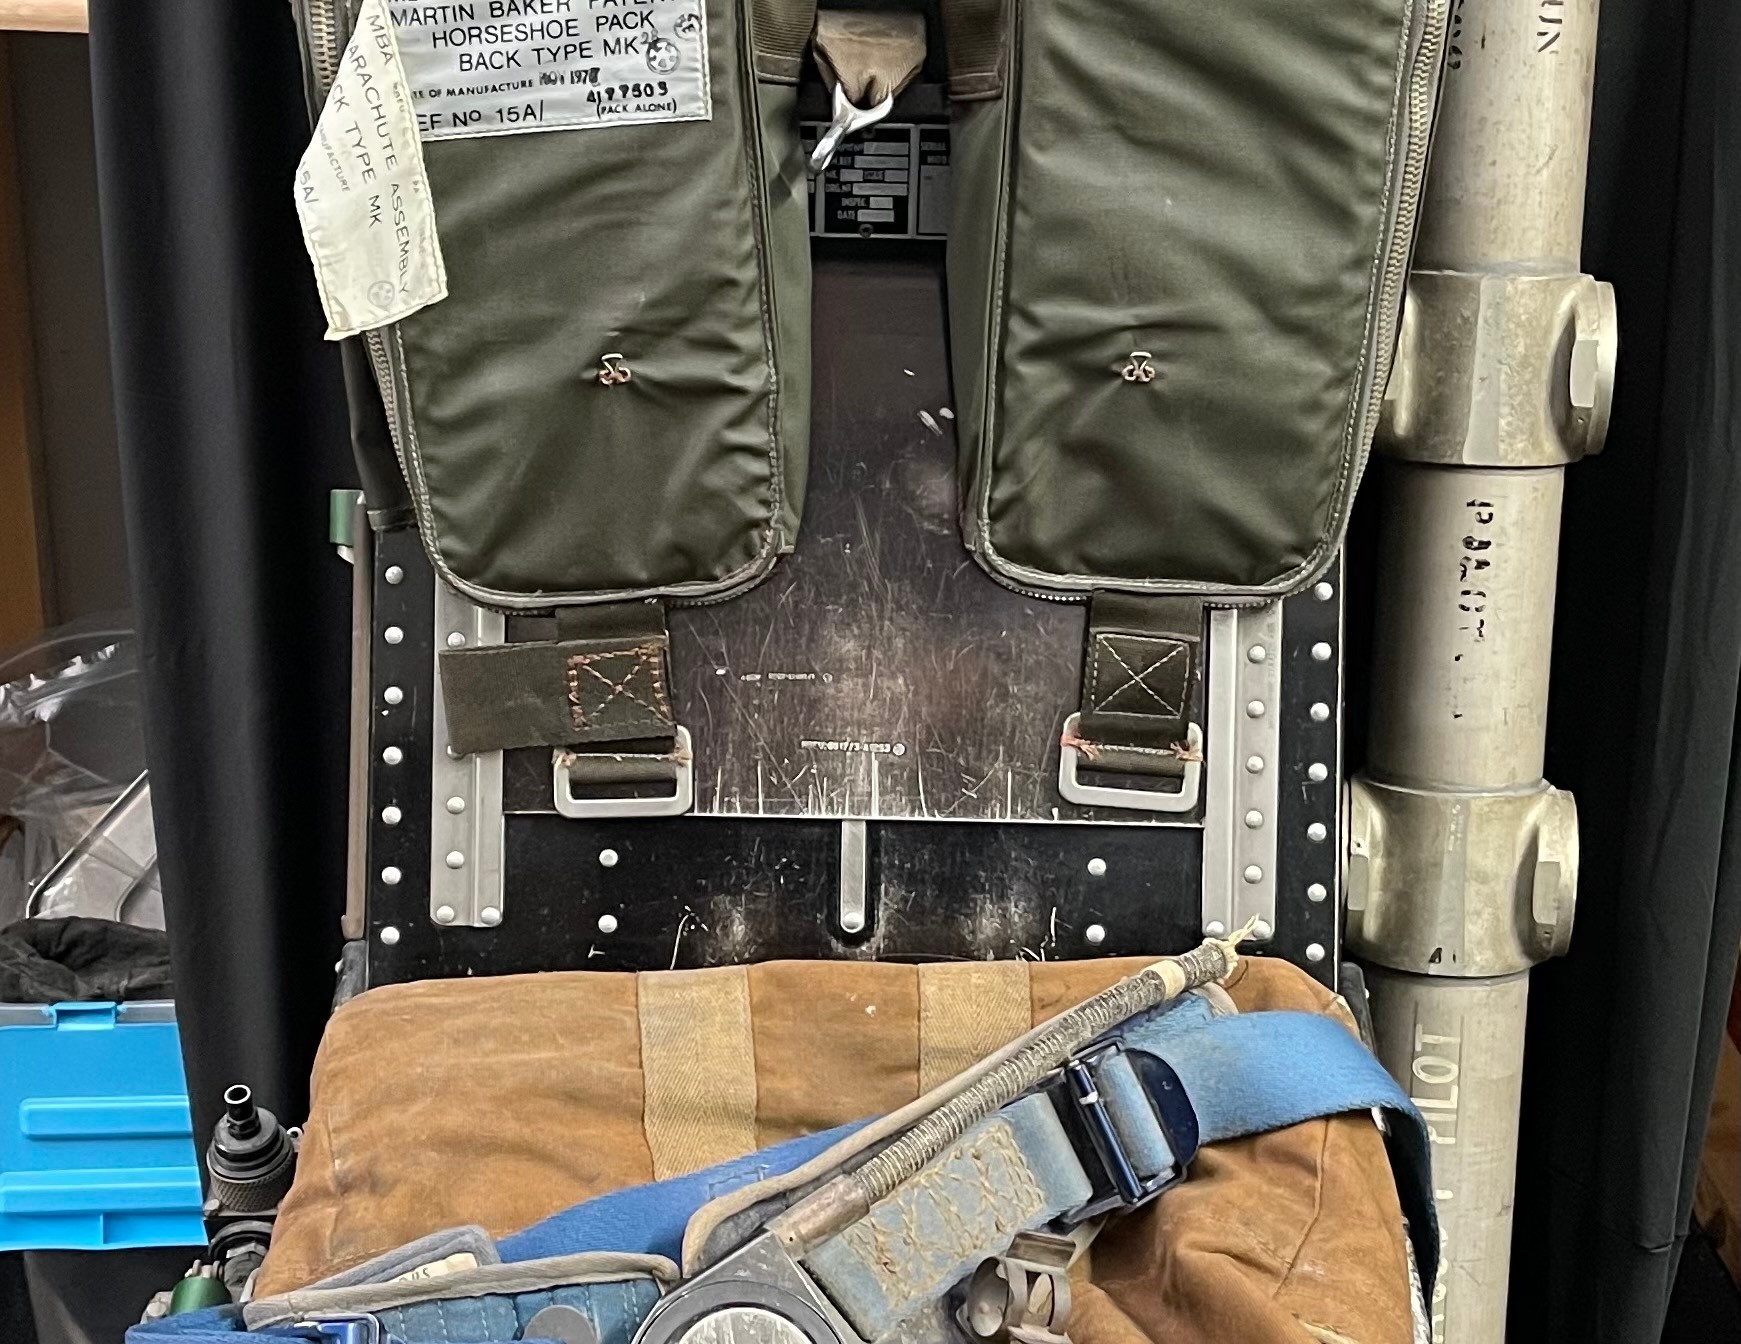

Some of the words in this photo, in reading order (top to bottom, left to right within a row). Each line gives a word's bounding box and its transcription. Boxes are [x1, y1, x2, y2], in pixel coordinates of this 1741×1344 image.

[390, 3, 475, 27] MARTIN
[432, 18, 580, 49] HORSESHOE
[596, 9, 655, 33] PACK
[365, 14, 394, 66] MBA
[459, 49, 522, 72] BACK
[531, 40, 593, 65] TYPE
[429, 89, 442, 99] OF
[446, 79, 533, 97] MANUFACTURE
[417, 113, 442, 132] EF
[496, 100, 544, 123] 15A/
[635, 98, 677, 115] ALONE)
[331, 84, 350, 113] CK
[345, 120, 376, 184] TYPE
[368, 194, 383, 229] MK
[348, 42, 398, 171] ARACHUTE
[390, 183, 410, 294] ASSEMBLY
